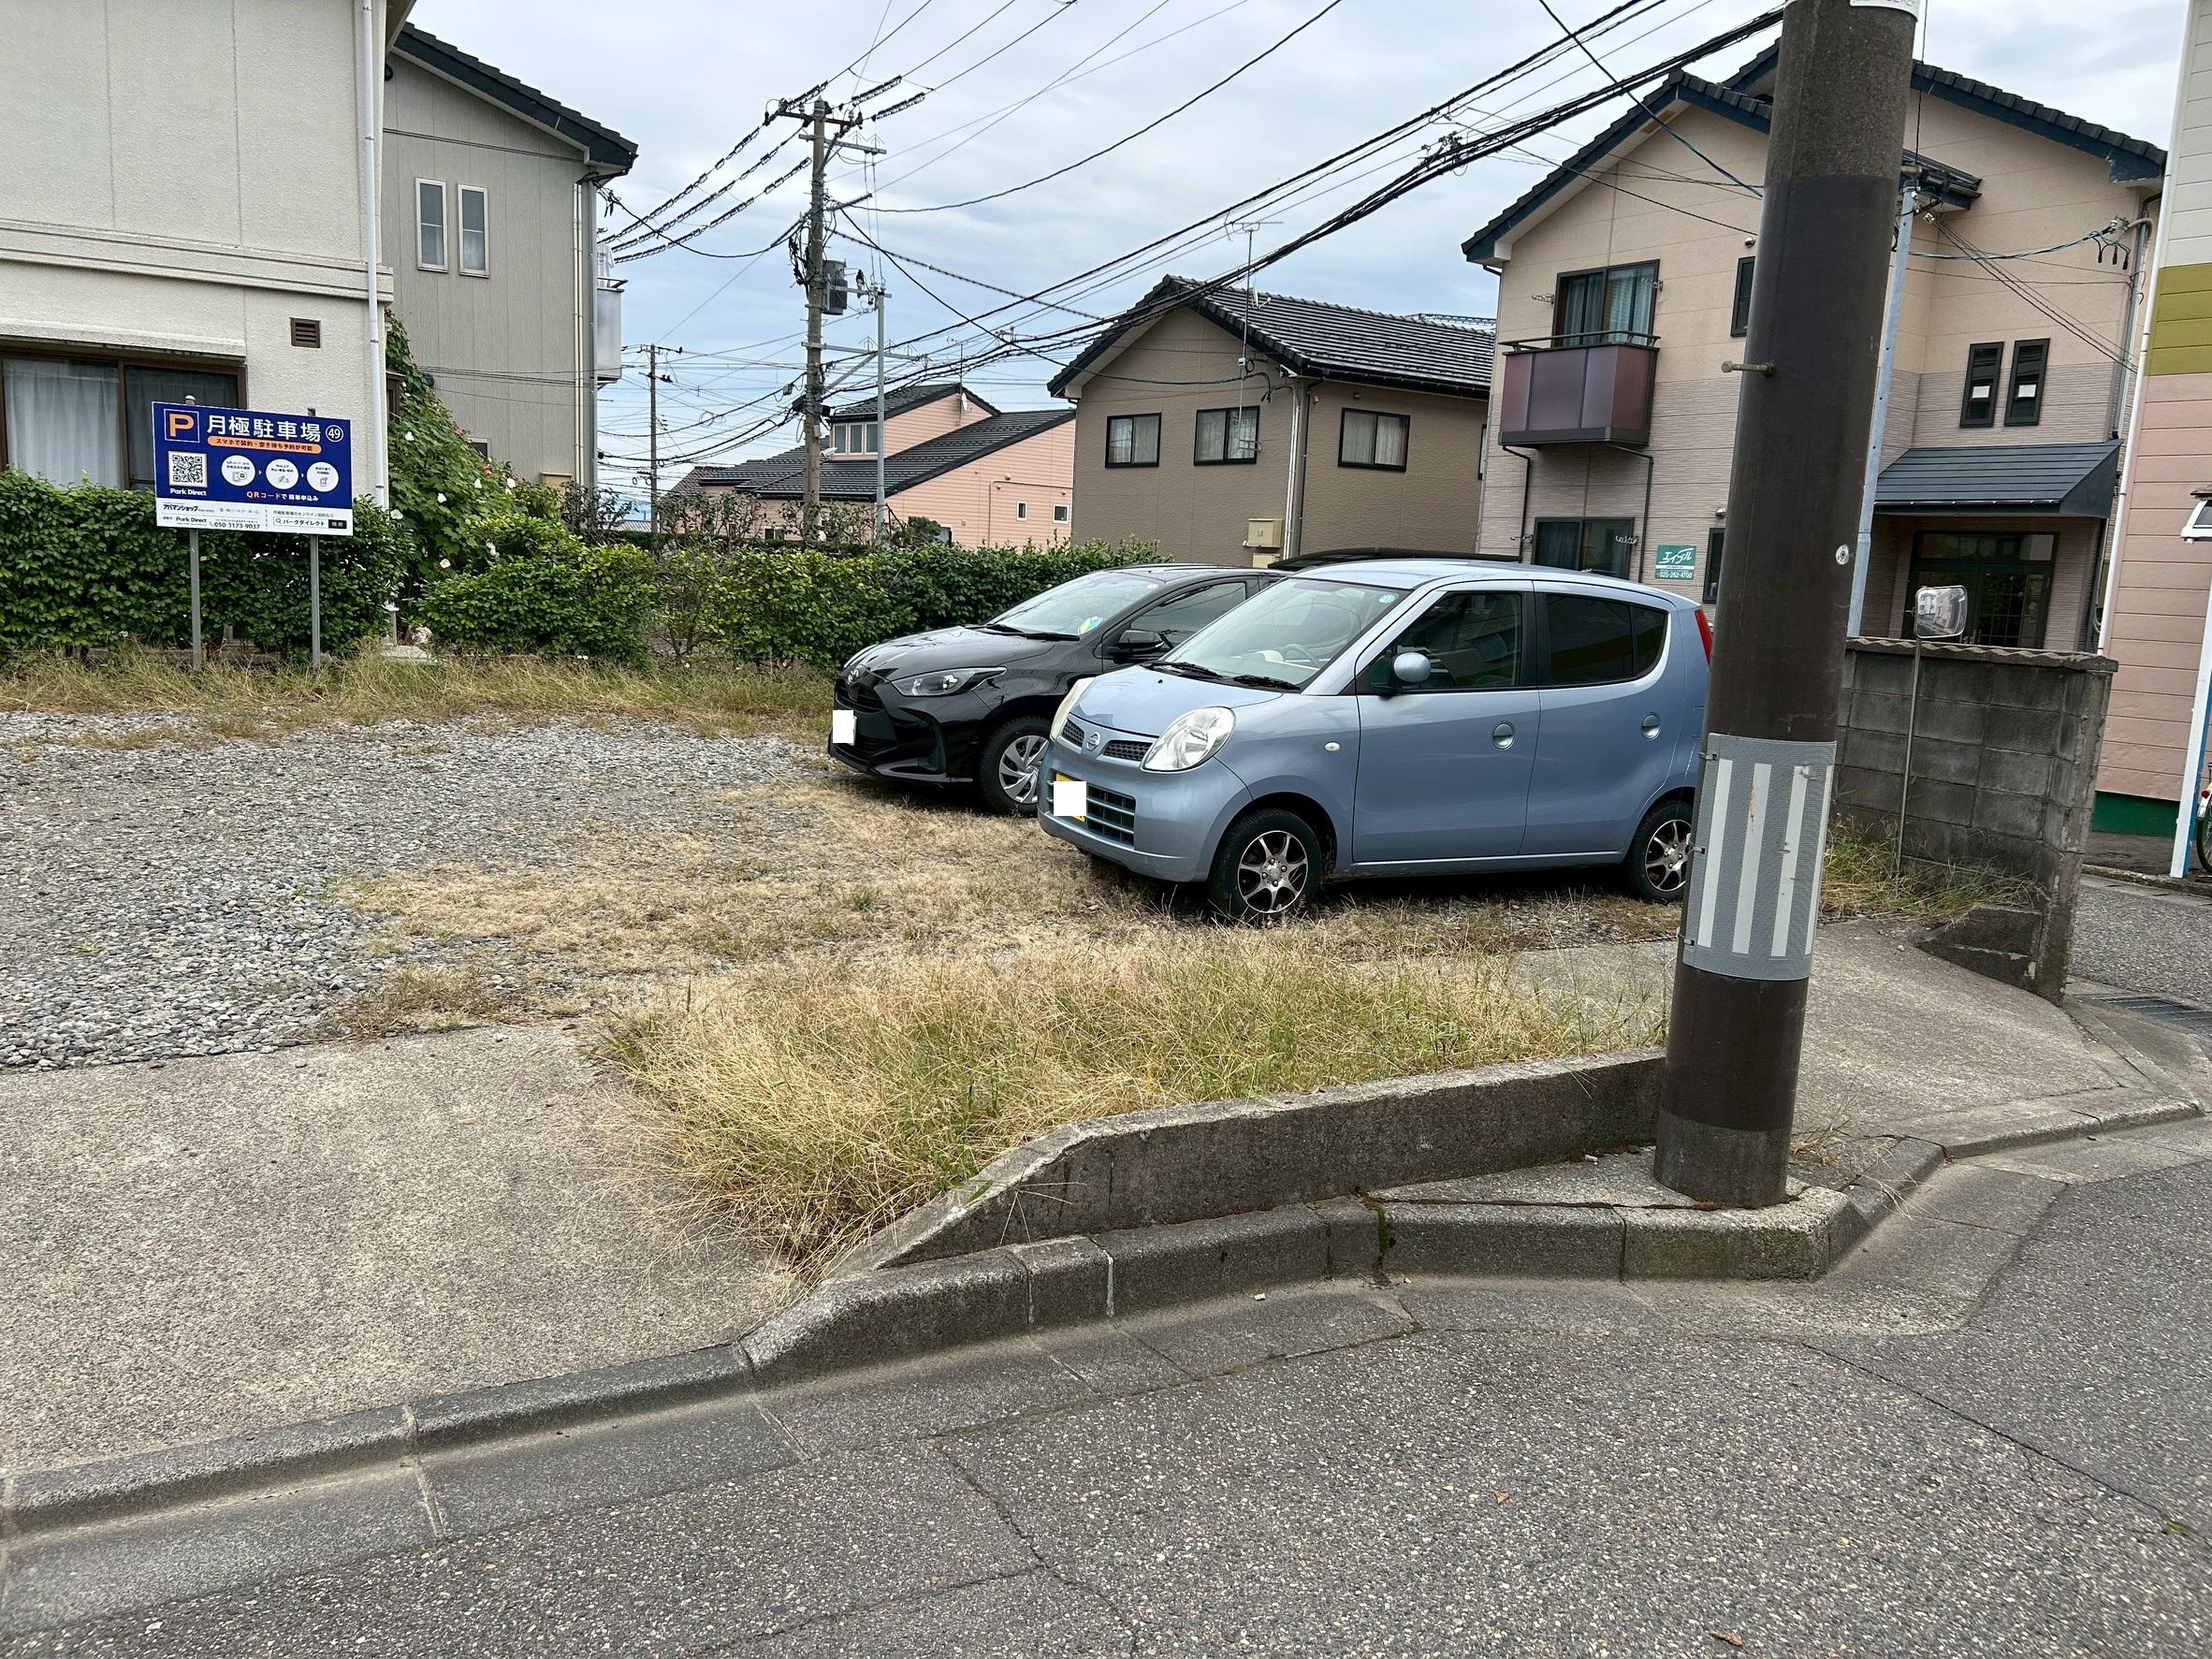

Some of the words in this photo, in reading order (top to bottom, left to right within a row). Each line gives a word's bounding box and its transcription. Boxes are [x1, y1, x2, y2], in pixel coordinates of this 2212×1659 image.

[169, 414, 195, 437] P
[207, 415, 321, 443] 月極駐車場
